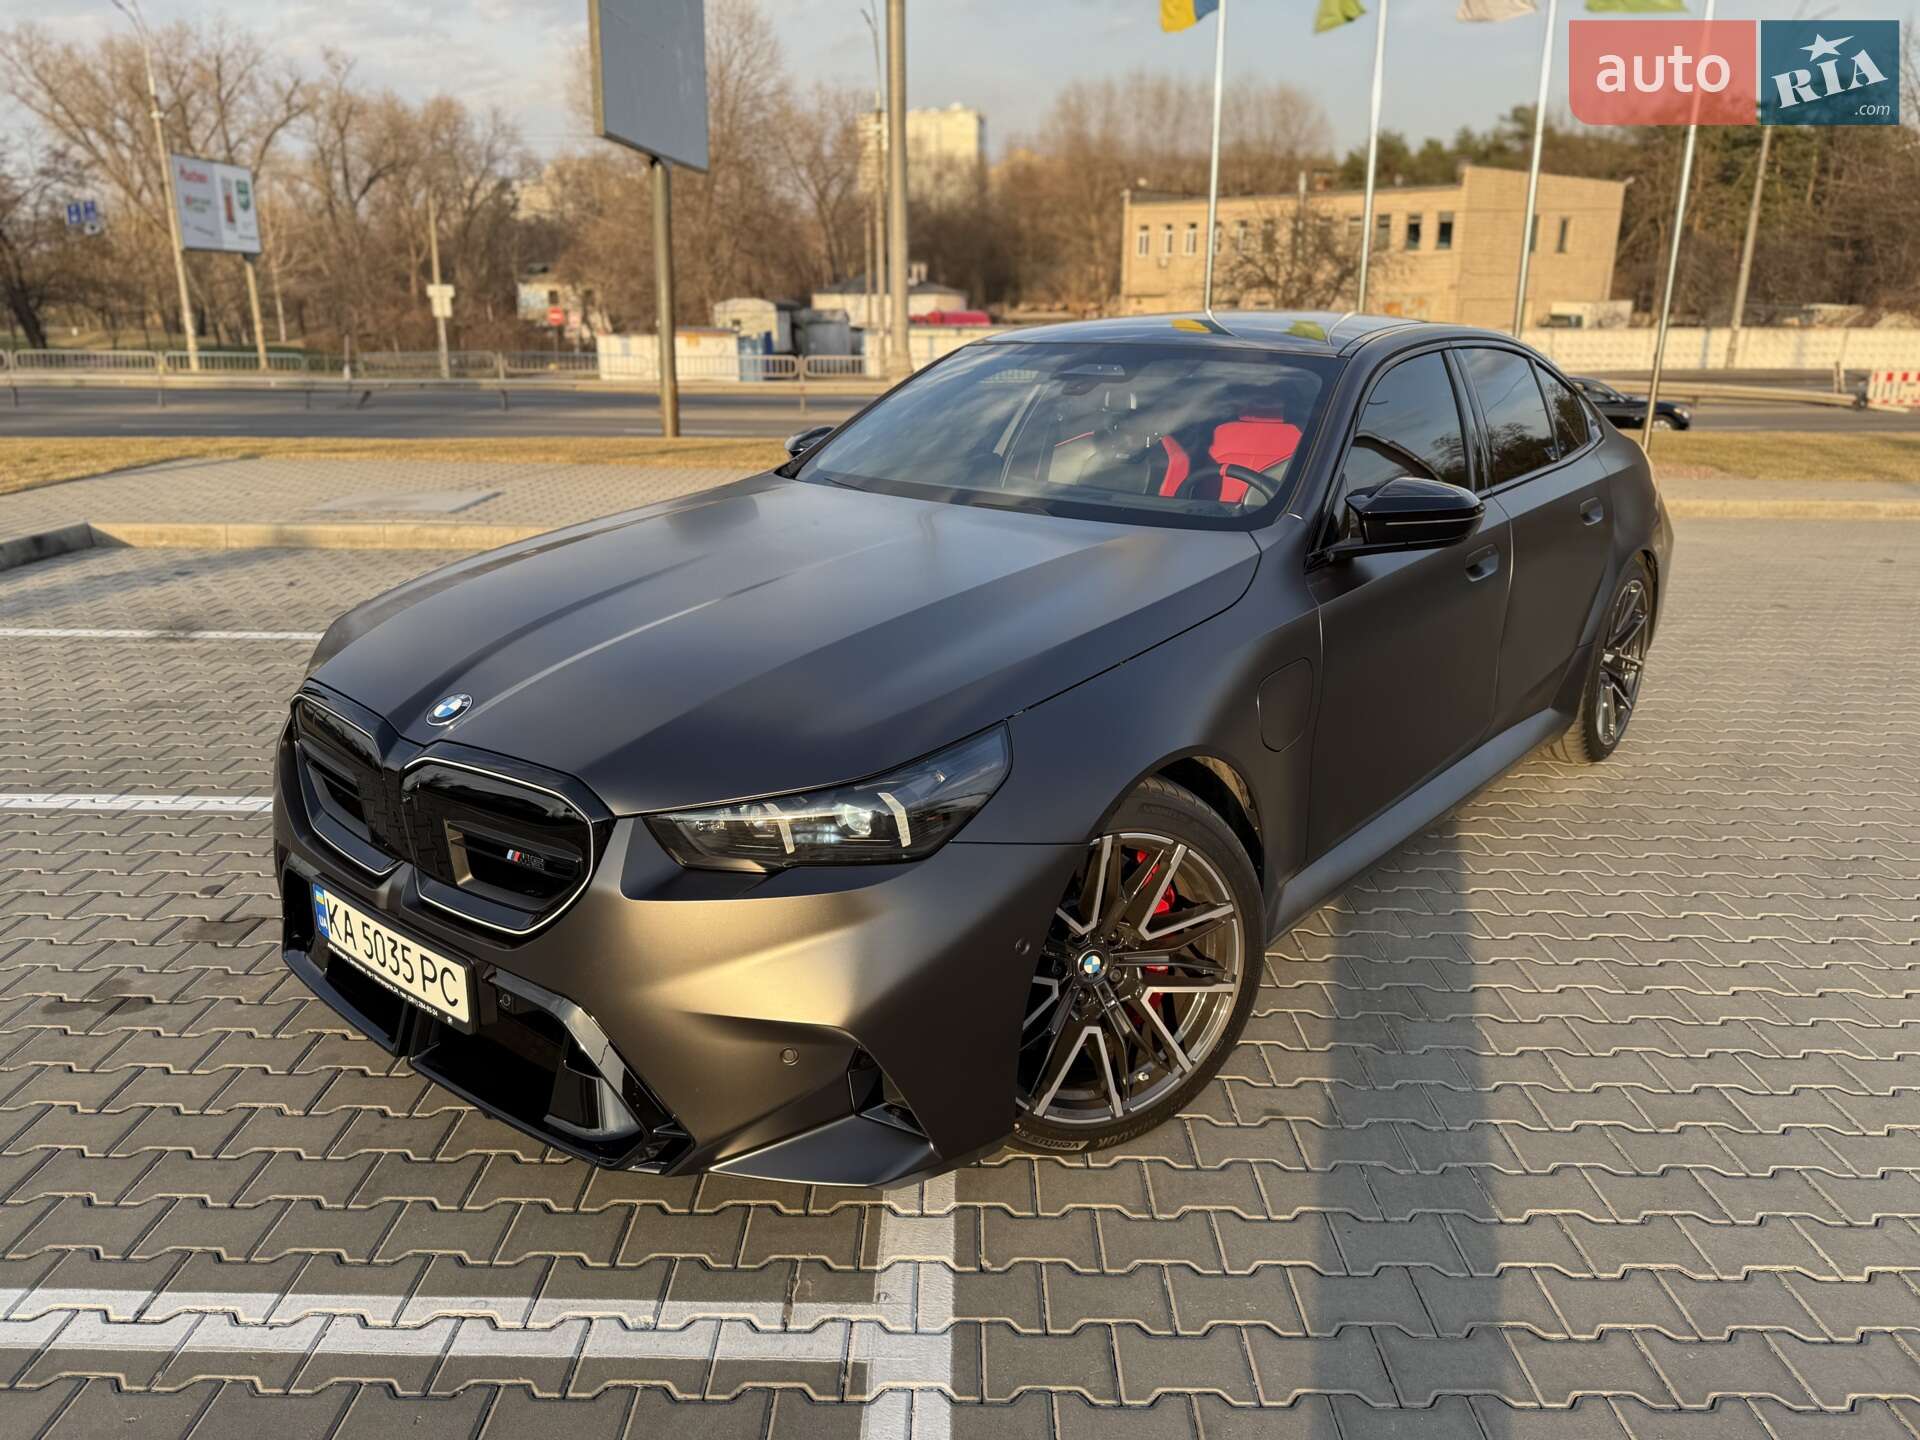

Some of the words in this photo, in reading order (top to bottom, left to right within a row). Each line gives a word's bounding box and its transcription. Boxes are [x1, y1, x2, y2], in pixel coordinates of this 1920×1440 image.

[326, 898, 358, 951] KA
[361, 921, 415, 984] 5035
[419, 953, 459, 1007] PC
